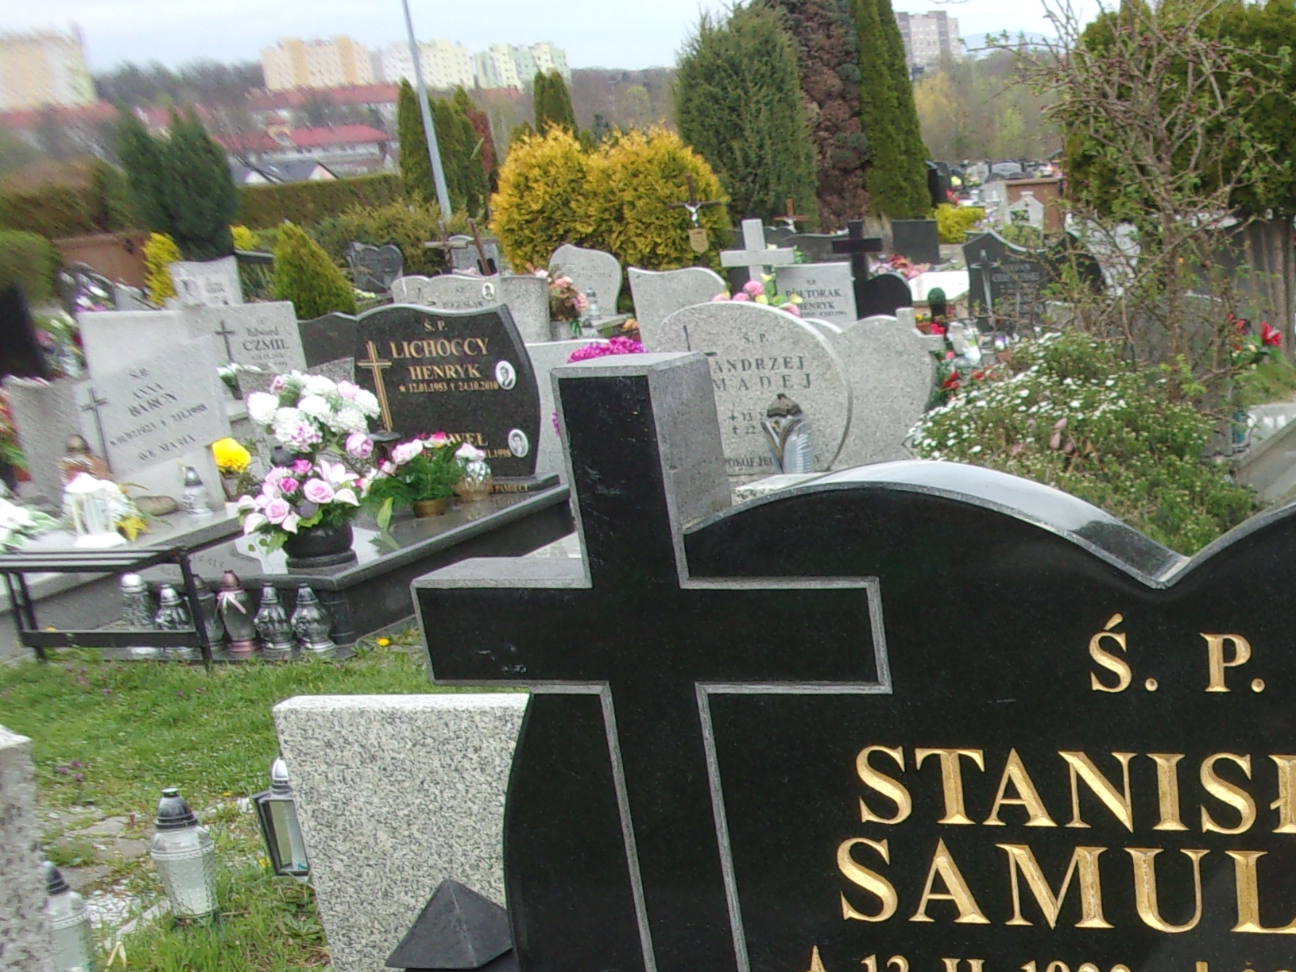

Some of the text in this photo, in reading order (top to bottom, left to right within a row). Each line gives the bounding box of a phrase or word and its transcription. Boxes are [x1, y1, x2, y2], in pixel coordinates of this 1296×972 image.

[389, 337, 489, 359] LICHOCCY
[408, 363, 481, 380] HENRYK
[713, 355, 806, 374] ANDRZEJ
[711, 373, 812, 392] MADEJ
[1088, 612, 1266, 694] Ś. P.
